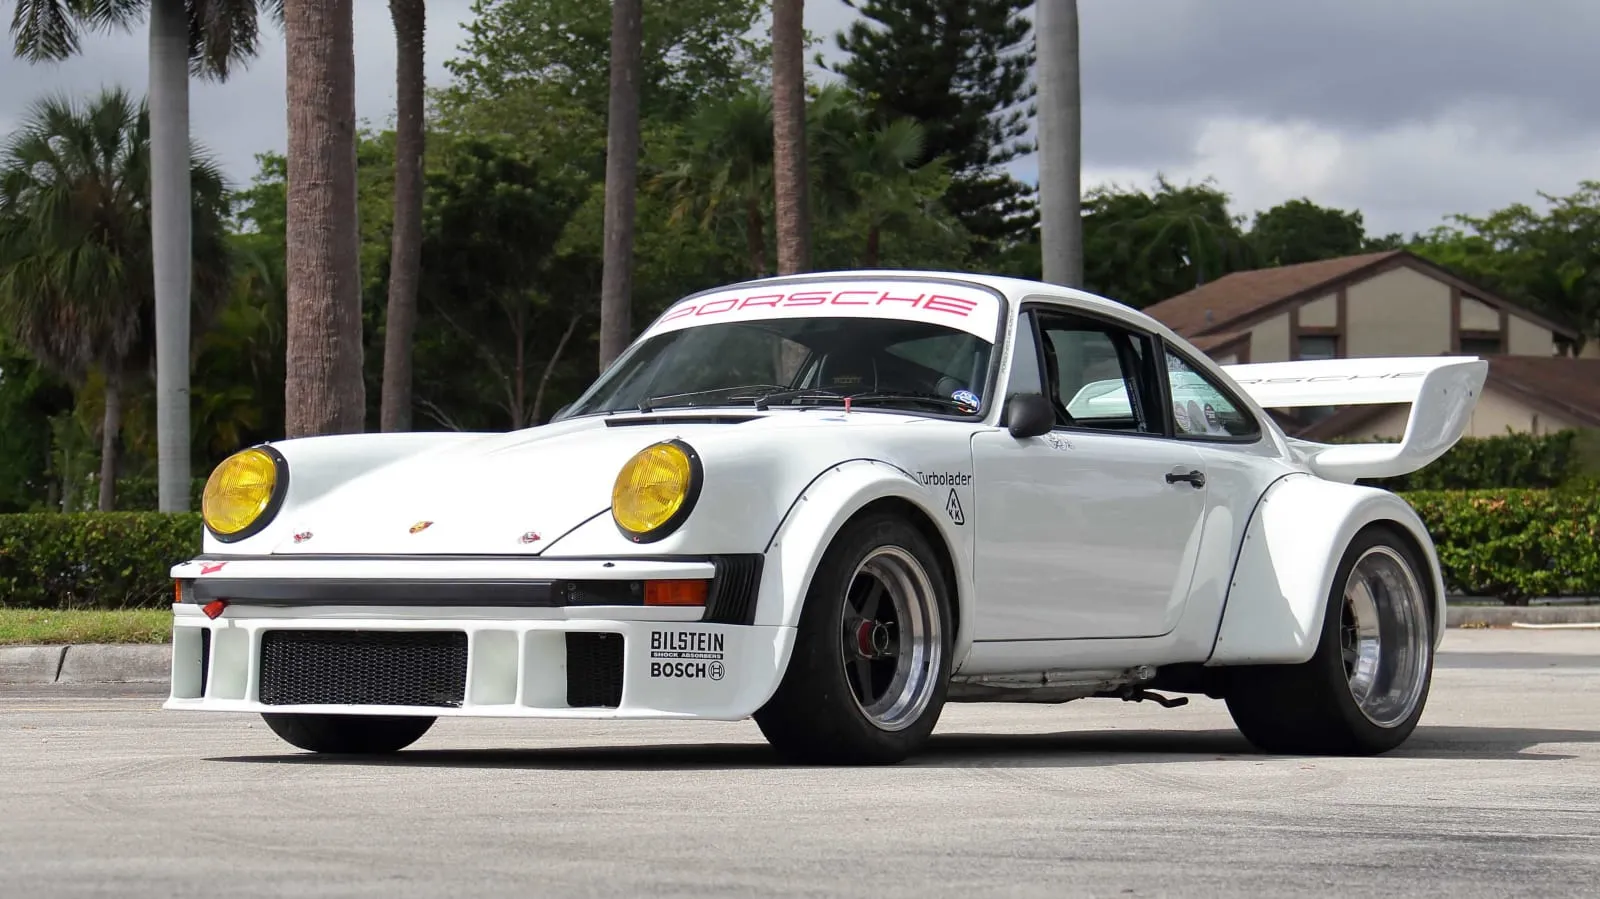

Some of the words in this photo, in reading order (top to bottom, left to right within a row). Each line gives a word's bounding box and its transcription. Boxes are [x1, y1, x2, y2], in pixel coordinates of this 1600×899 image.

[656, 291, 978, 326] PORSCHE
[917, 471, 972, 486] Turbolader
[651, 631, 723, 651] BILSTEIN
[651, 662, 706, 678] BOSCH
